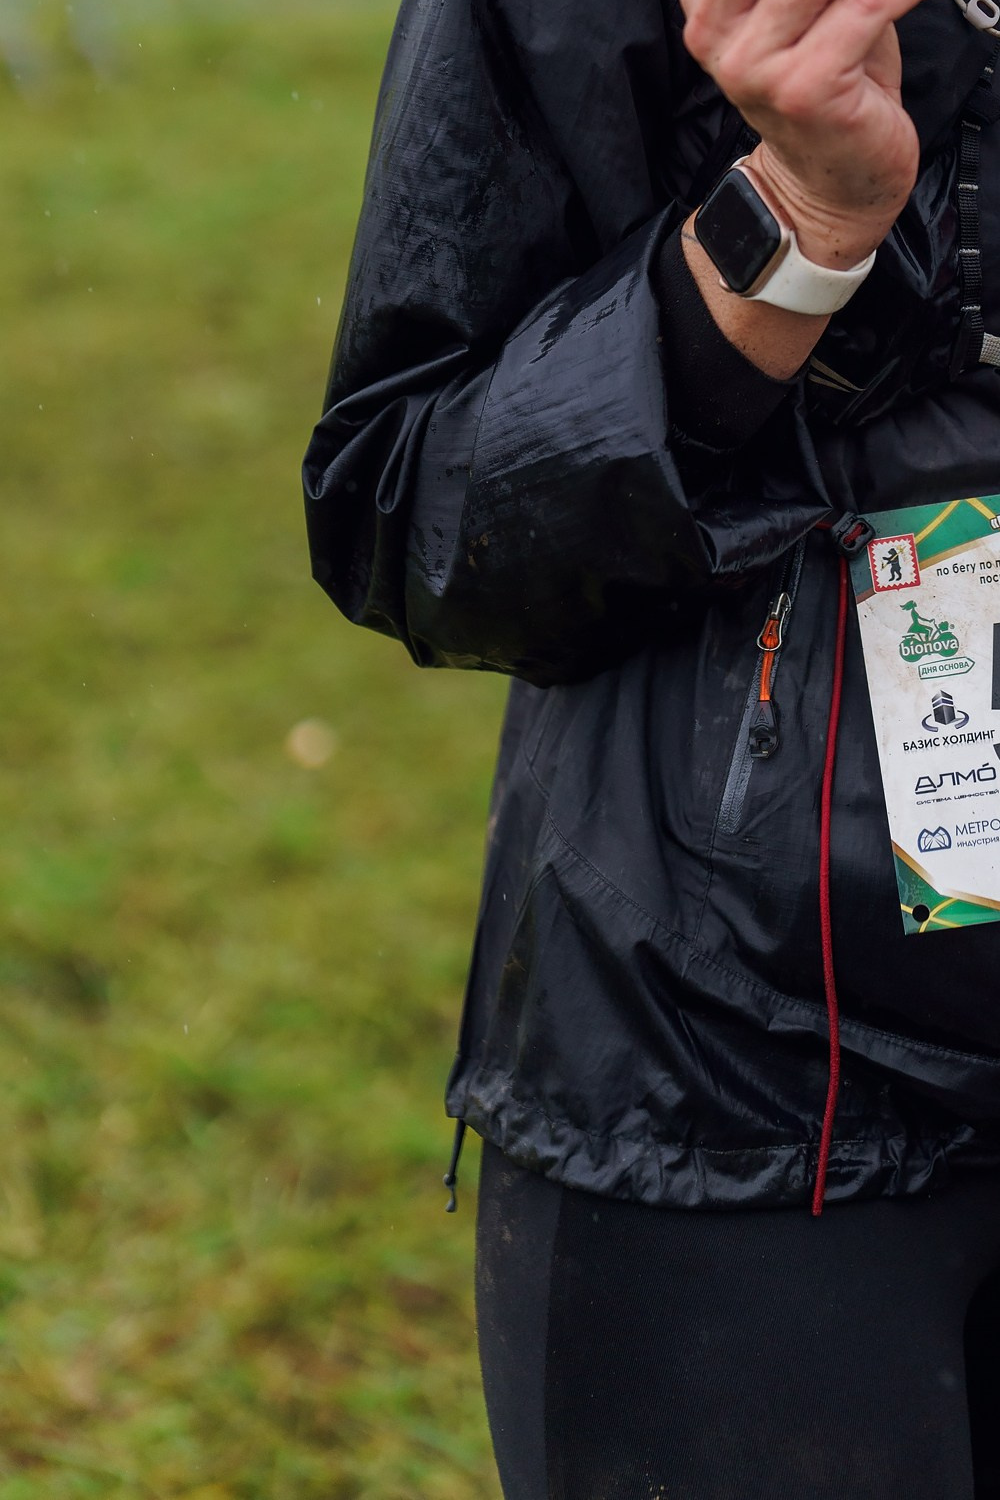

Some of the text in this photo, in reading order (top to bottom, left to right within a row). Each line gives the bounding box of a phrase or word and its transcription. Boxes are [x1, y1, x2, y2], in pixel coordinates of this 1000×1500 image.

[937, 567, 949, 576] по
[952, 562, 976, 575] бегу
[980, 560, 992, 570] по
[901, 638, 959, 657] bionova
[921, 661, 970, 676] ДНЯ ОСНОВА
[903, 729, 996, 751] БАЗИС ХОЛДИНГ
